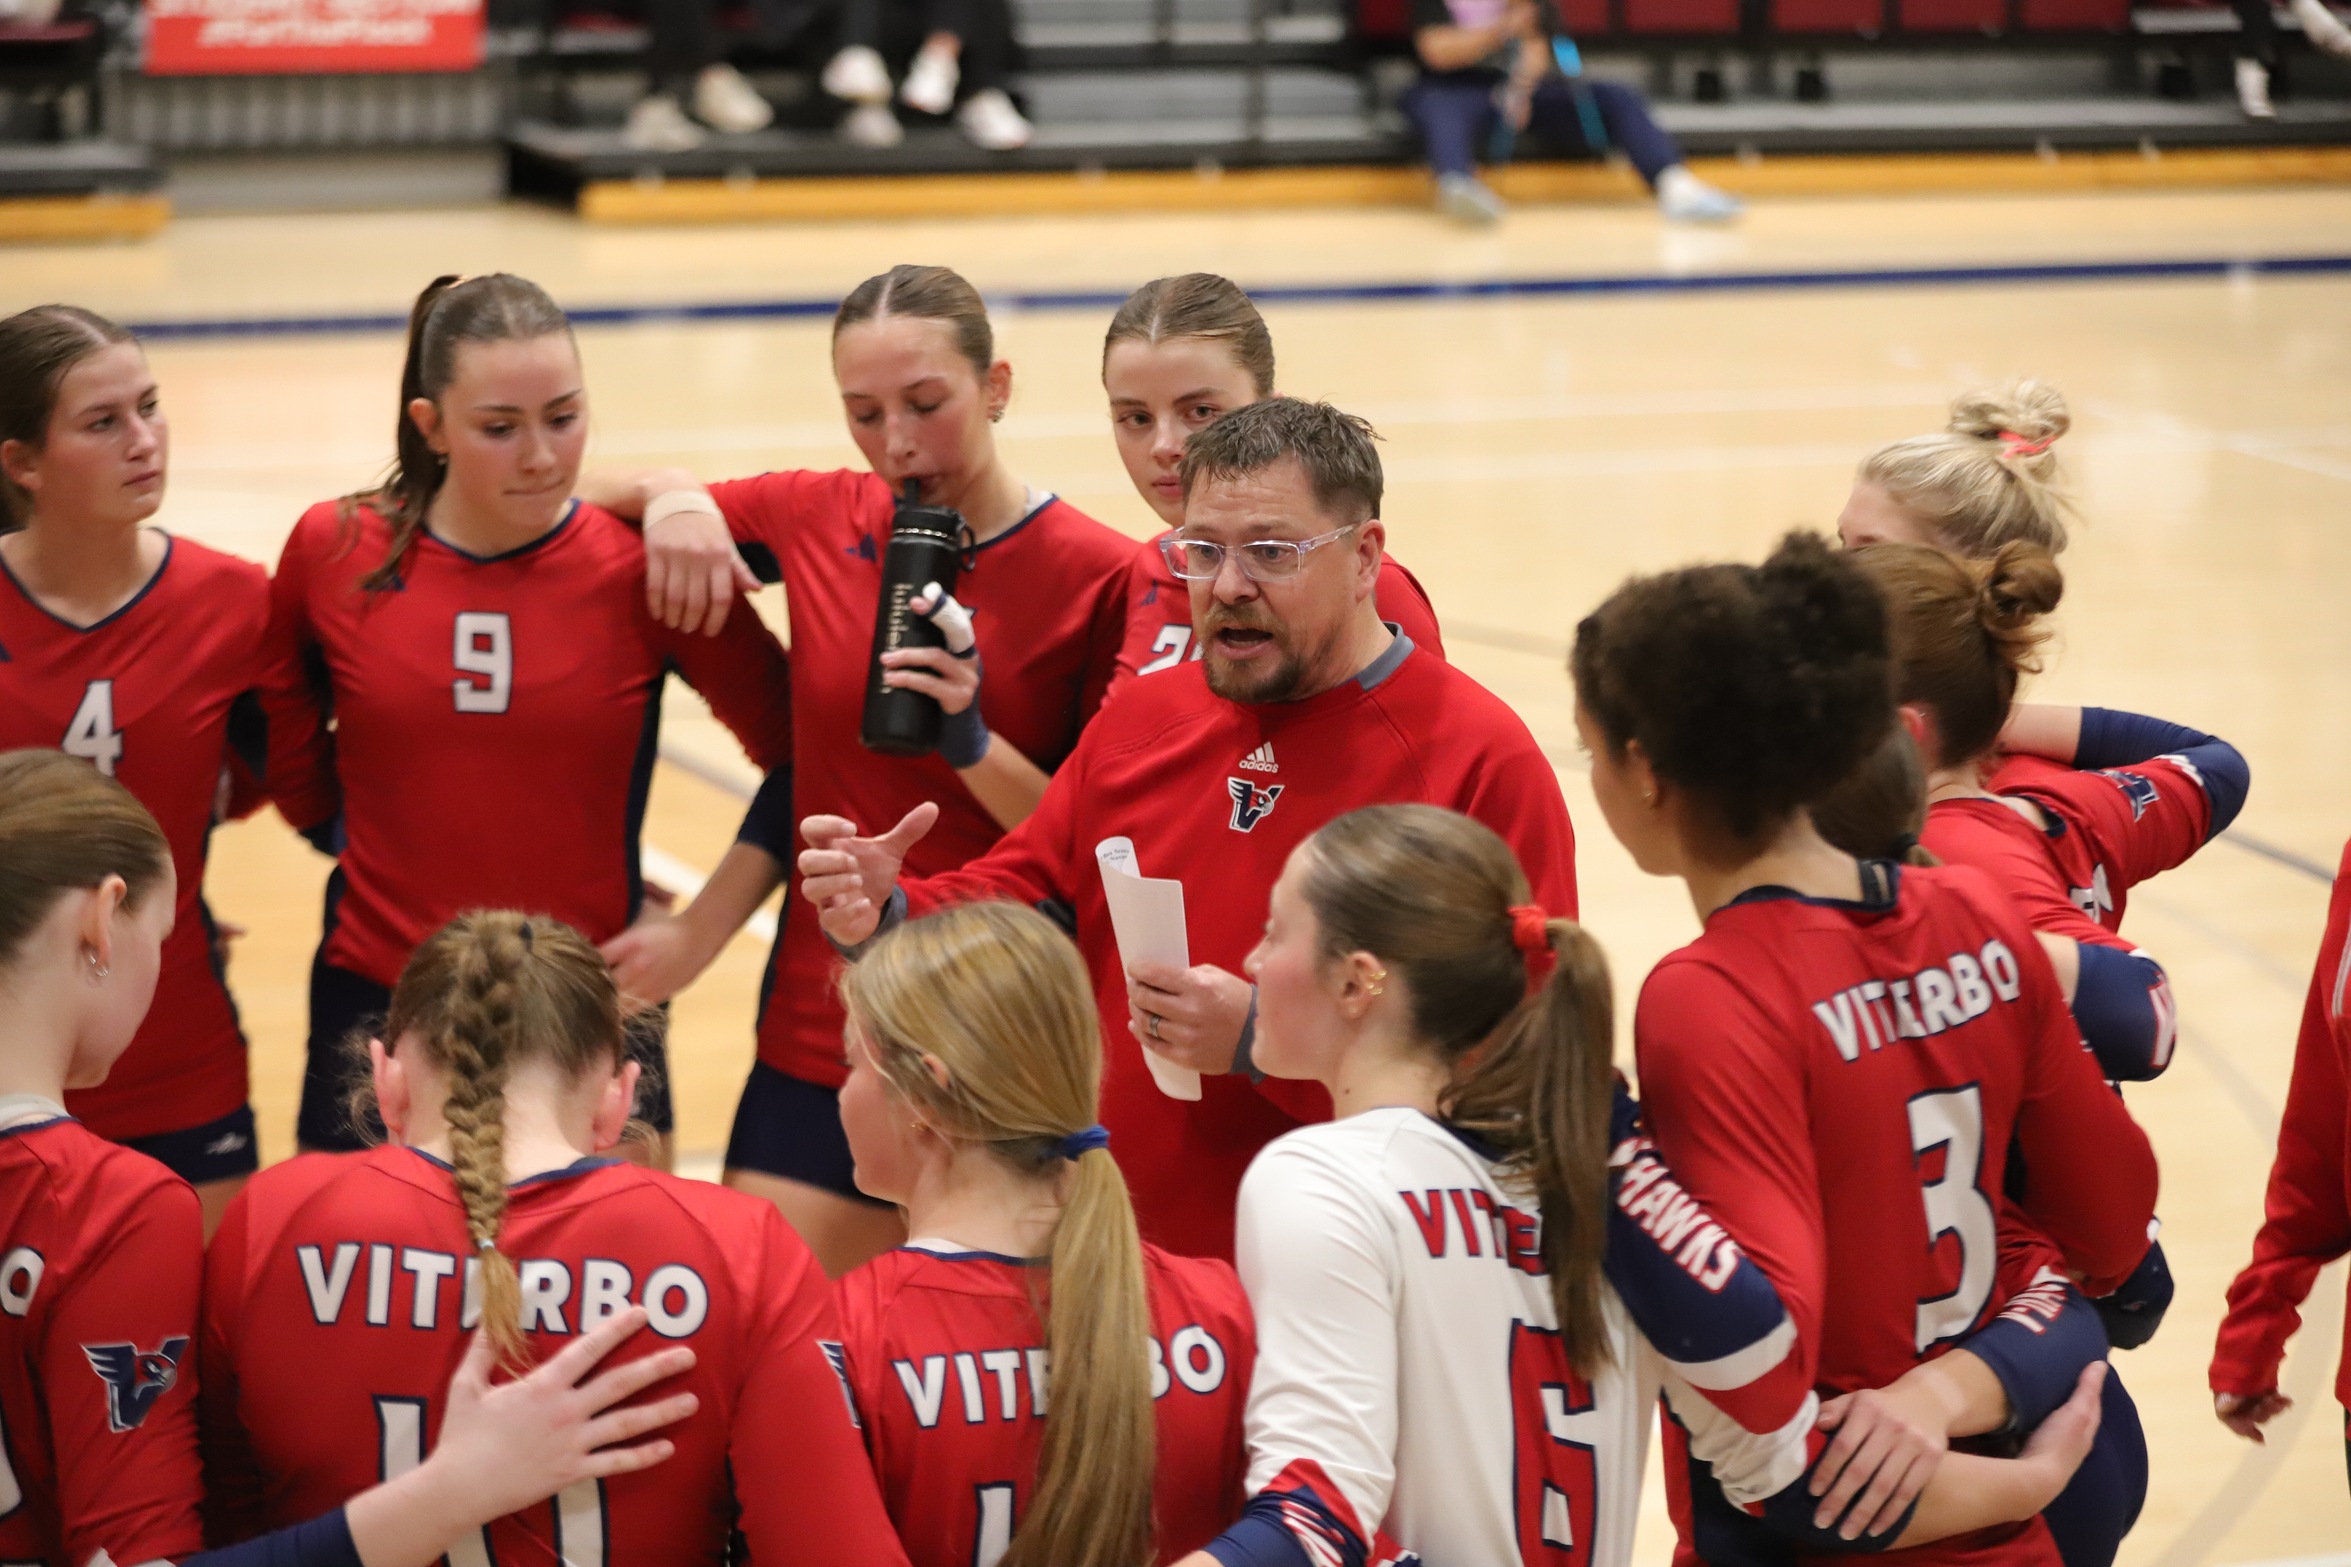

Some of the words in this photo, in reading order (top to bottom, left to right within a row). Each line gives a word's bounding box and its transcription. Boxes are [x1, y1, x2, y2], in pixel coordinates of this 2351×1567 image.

[452, 611, 513, 713] 9
[1136, 623, 1205, 677] 2
[61, 678, 124, 777] 4
[1239, 759, 1279, 774] adidas
[1813, 938, 2021, 1062] VITERBO
[1907, 1081, 1998, 1359] 3
[1507, 1317, 1598, 1567] 6
